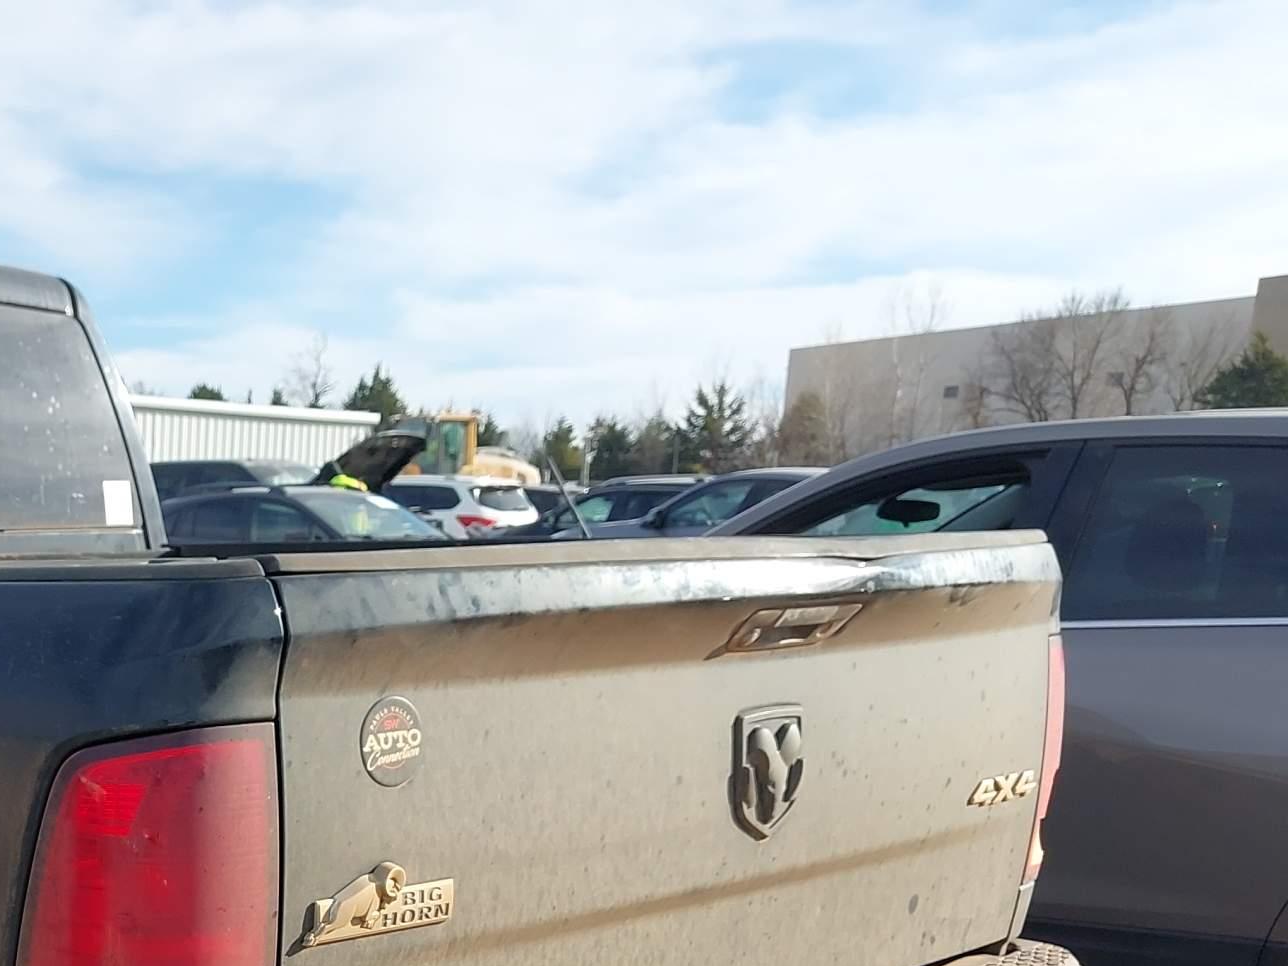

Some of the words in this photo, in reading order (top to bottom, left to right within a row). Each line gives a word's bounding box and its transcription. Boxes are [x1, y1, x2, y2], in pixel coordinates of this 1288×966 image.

[362, 728, 422, 752] AUTO
[367, 744, 420, 771] Connection
[402, 886, 442, 905] BIG
[382, 902, 450, 927] HORN
